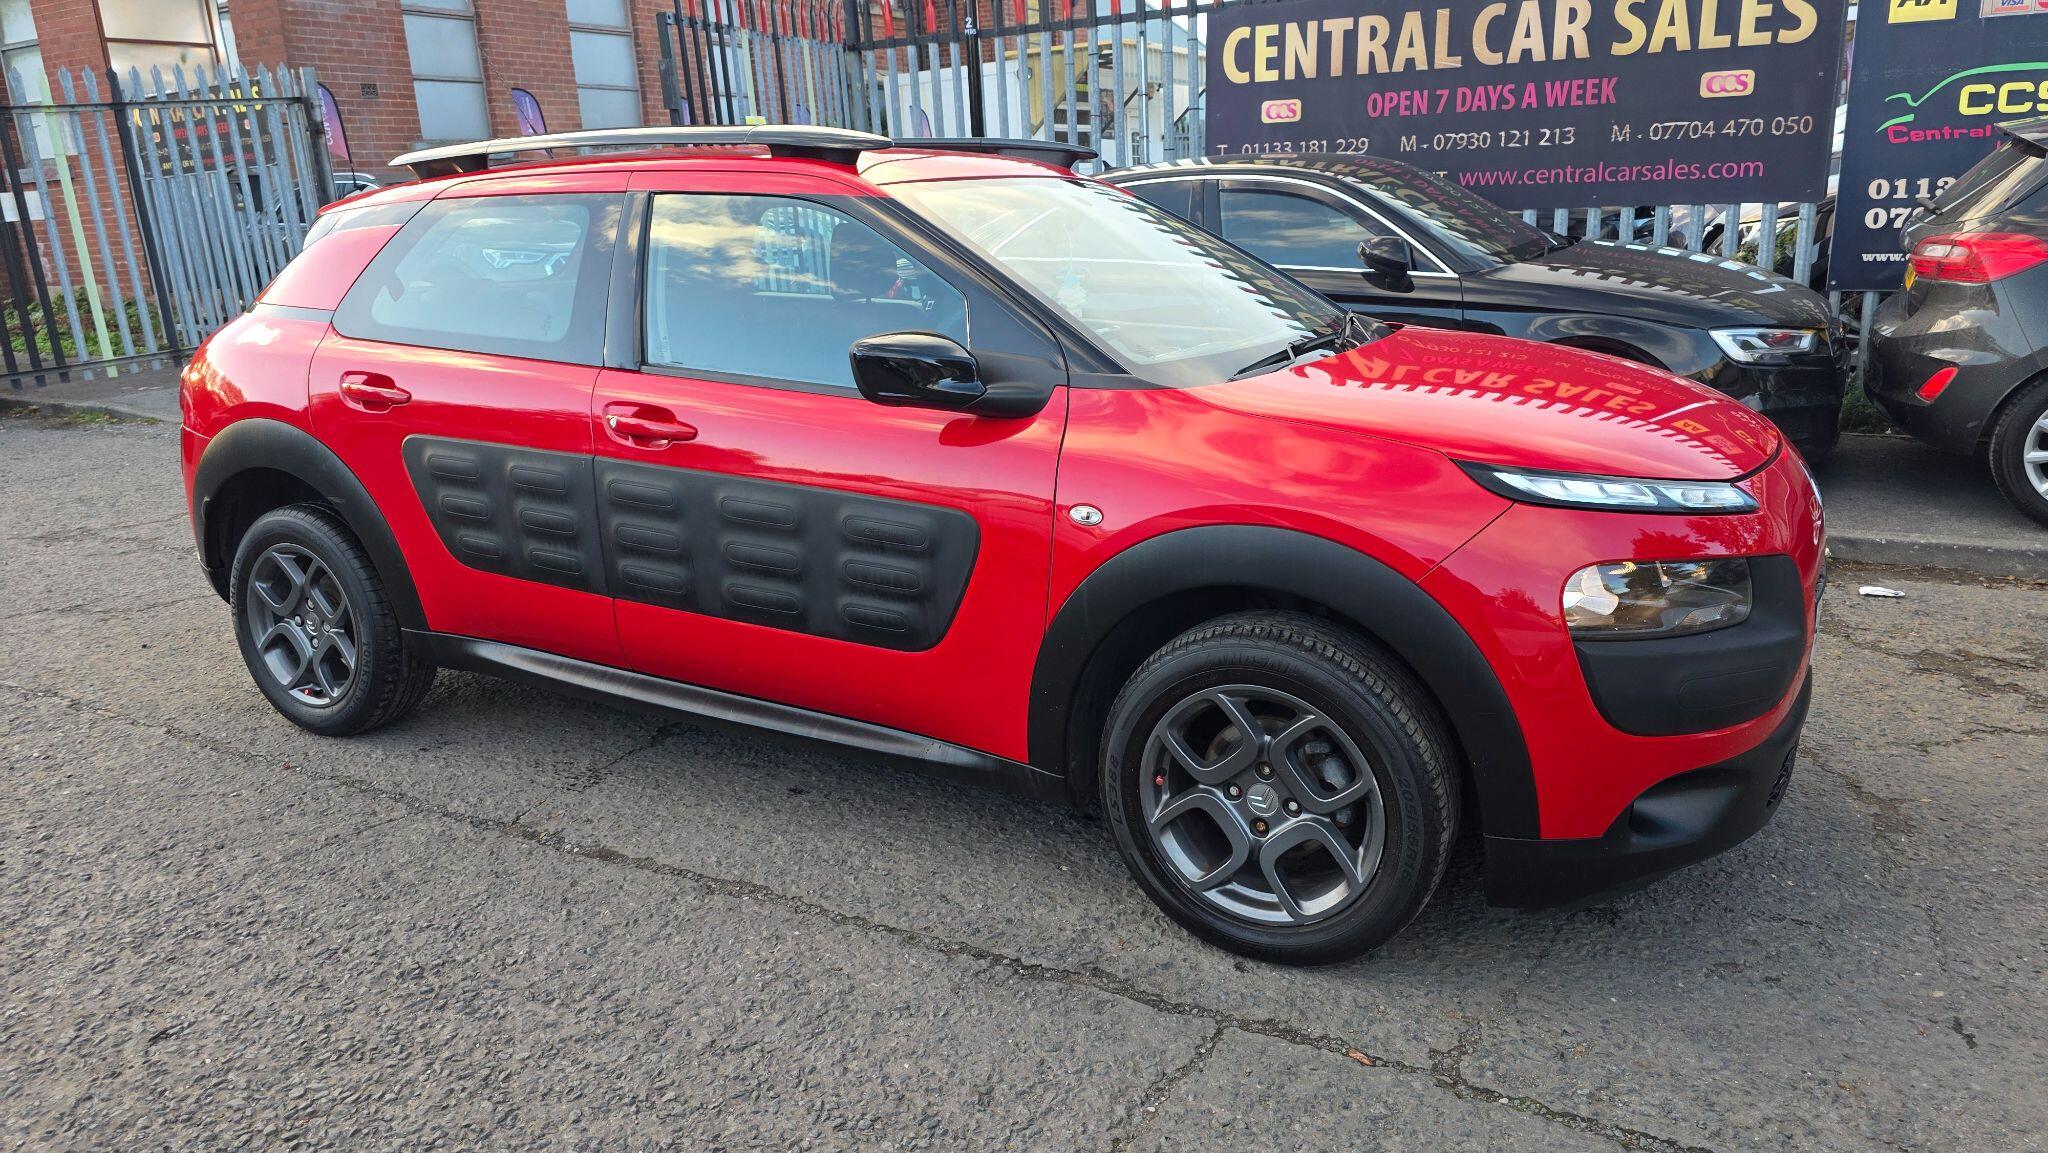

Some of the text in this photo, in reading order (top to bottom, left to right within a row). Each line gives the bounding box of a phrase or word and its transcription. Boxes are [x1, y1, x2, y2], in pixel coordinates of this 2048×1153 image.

[1222, 0, 1819, 84] CENTRAL CAR SALES
[1706, 73, 1749, 94] CCS
[1367, 77, 1619, 118] OPEN 7 DAYS A WEEK
[1433, 131, 1491, 151] 07930
[1499, 129, 1530, 148] 121
[1538, 127, 1576, 146] 213
[1649, 120, 1716, 141] 07704
[1721, 118, 1765, 138] 470
[1771, 115, 1814, 136] 050
[1887, 124, 1992, 144] Central
[1336, 138, 1370, 154] 229
[1459, 158, 1764, 188] www.centralcarsales.com
[1864, 206, 1924, 230] 07
